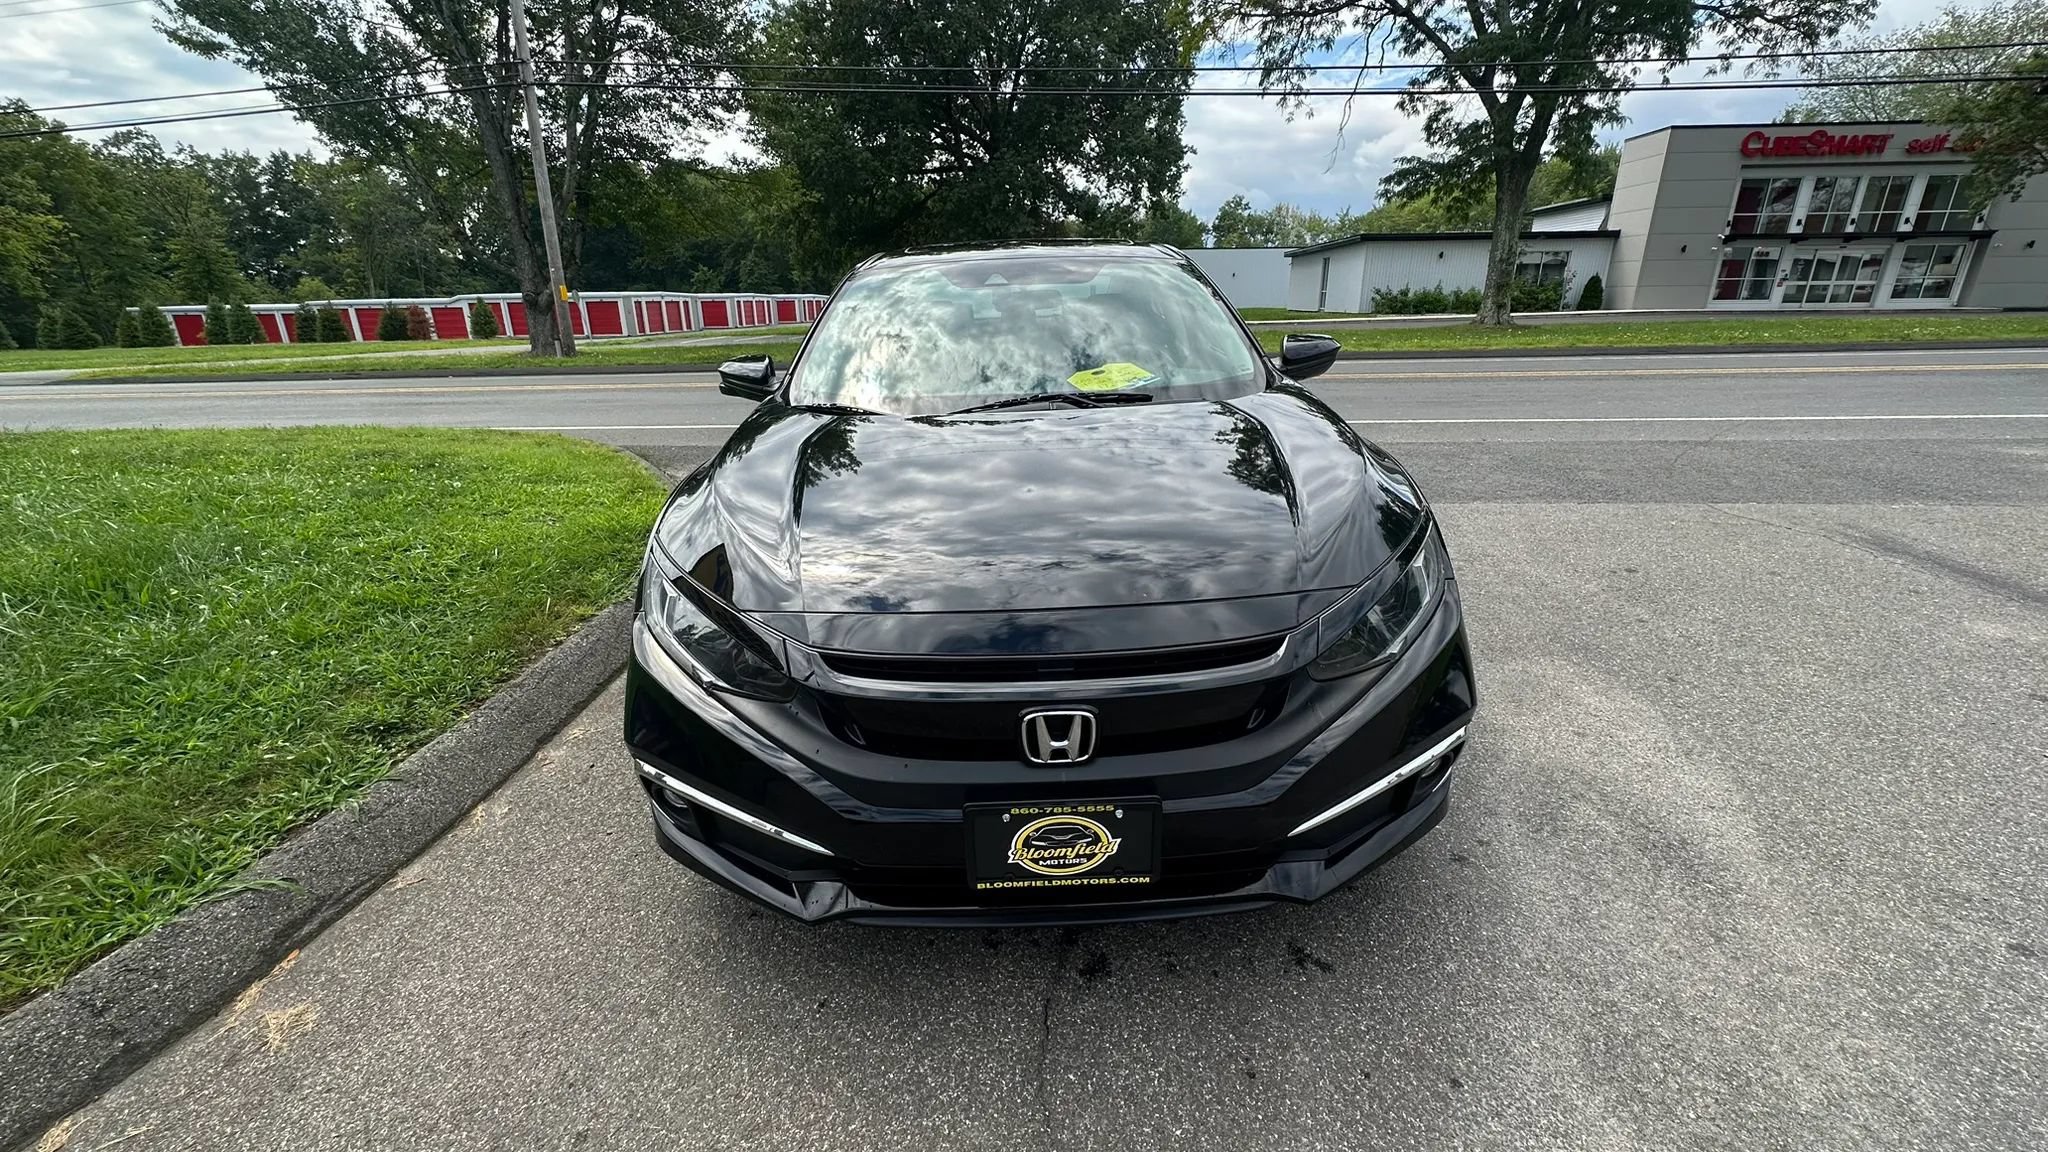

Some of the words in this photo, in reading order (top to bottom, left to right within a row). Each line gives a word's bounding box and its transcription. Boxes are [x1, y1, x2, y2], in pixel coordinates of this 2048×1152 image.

[1010, 805, 1115, 815] 860-785-5555
[1014, 842, 1116, 860] Bloomfield
[1039, 858, 1087, 866] MOTORS
[977, 877, 1150, 889] BLOOMFIELDMOTORS.COM
